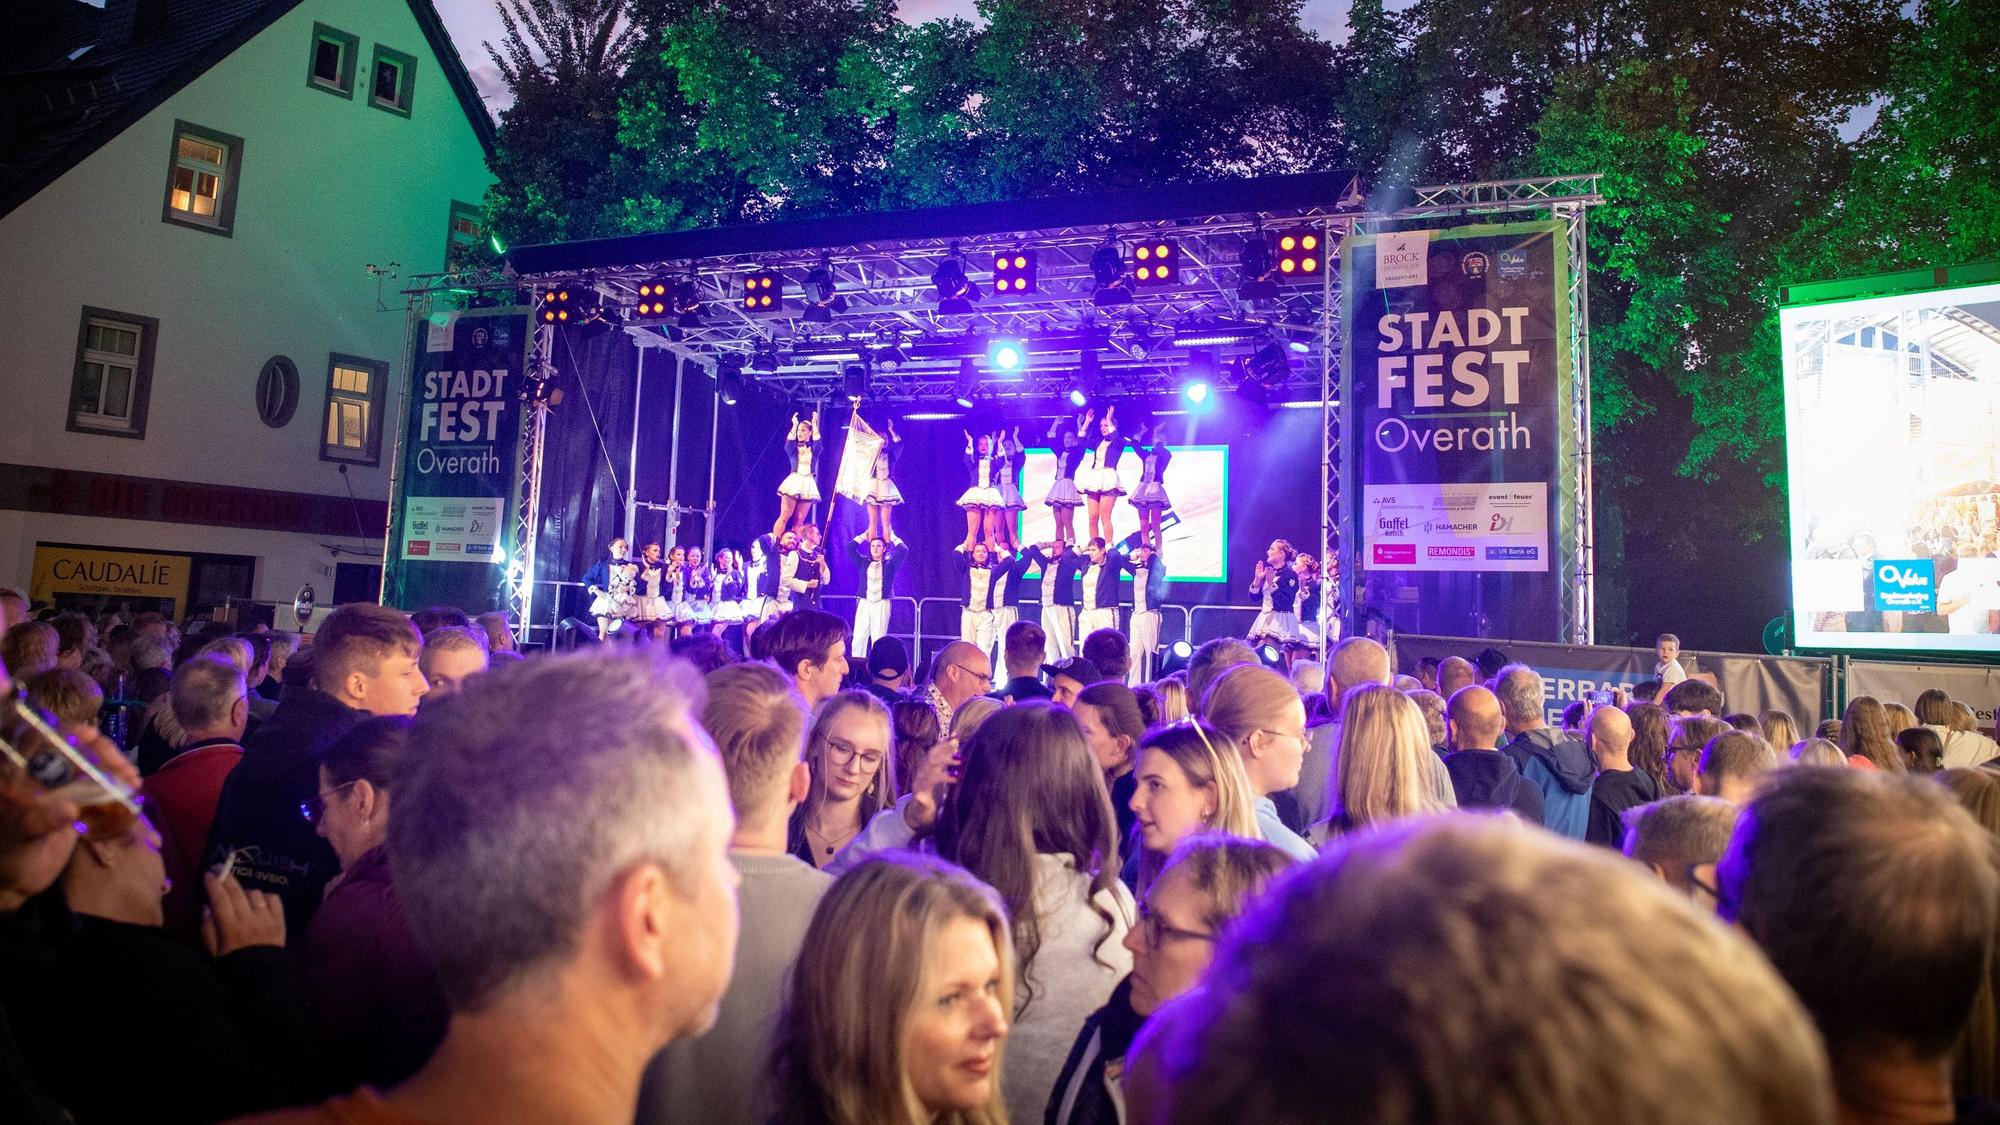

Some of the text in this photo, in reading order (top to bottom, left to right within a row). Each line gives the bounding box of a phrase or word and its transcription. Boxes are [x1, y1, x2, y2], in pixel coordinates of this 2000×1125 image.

[1384, 253, 1419, 265] BROCK
[1377, 307, 1529, 352] STADT
[424, 369, 508, 400] STADT
[1378, 351, 1530, 409] FEST
[420, 401, 505, 442] FEST
[1375, 411, 1531, 452] Overath
[417, 446, 500, 475] Overath
[1379, 517, 1409, 530] Gaffel
[1436, 523, 1478, 531] HAMACHER
